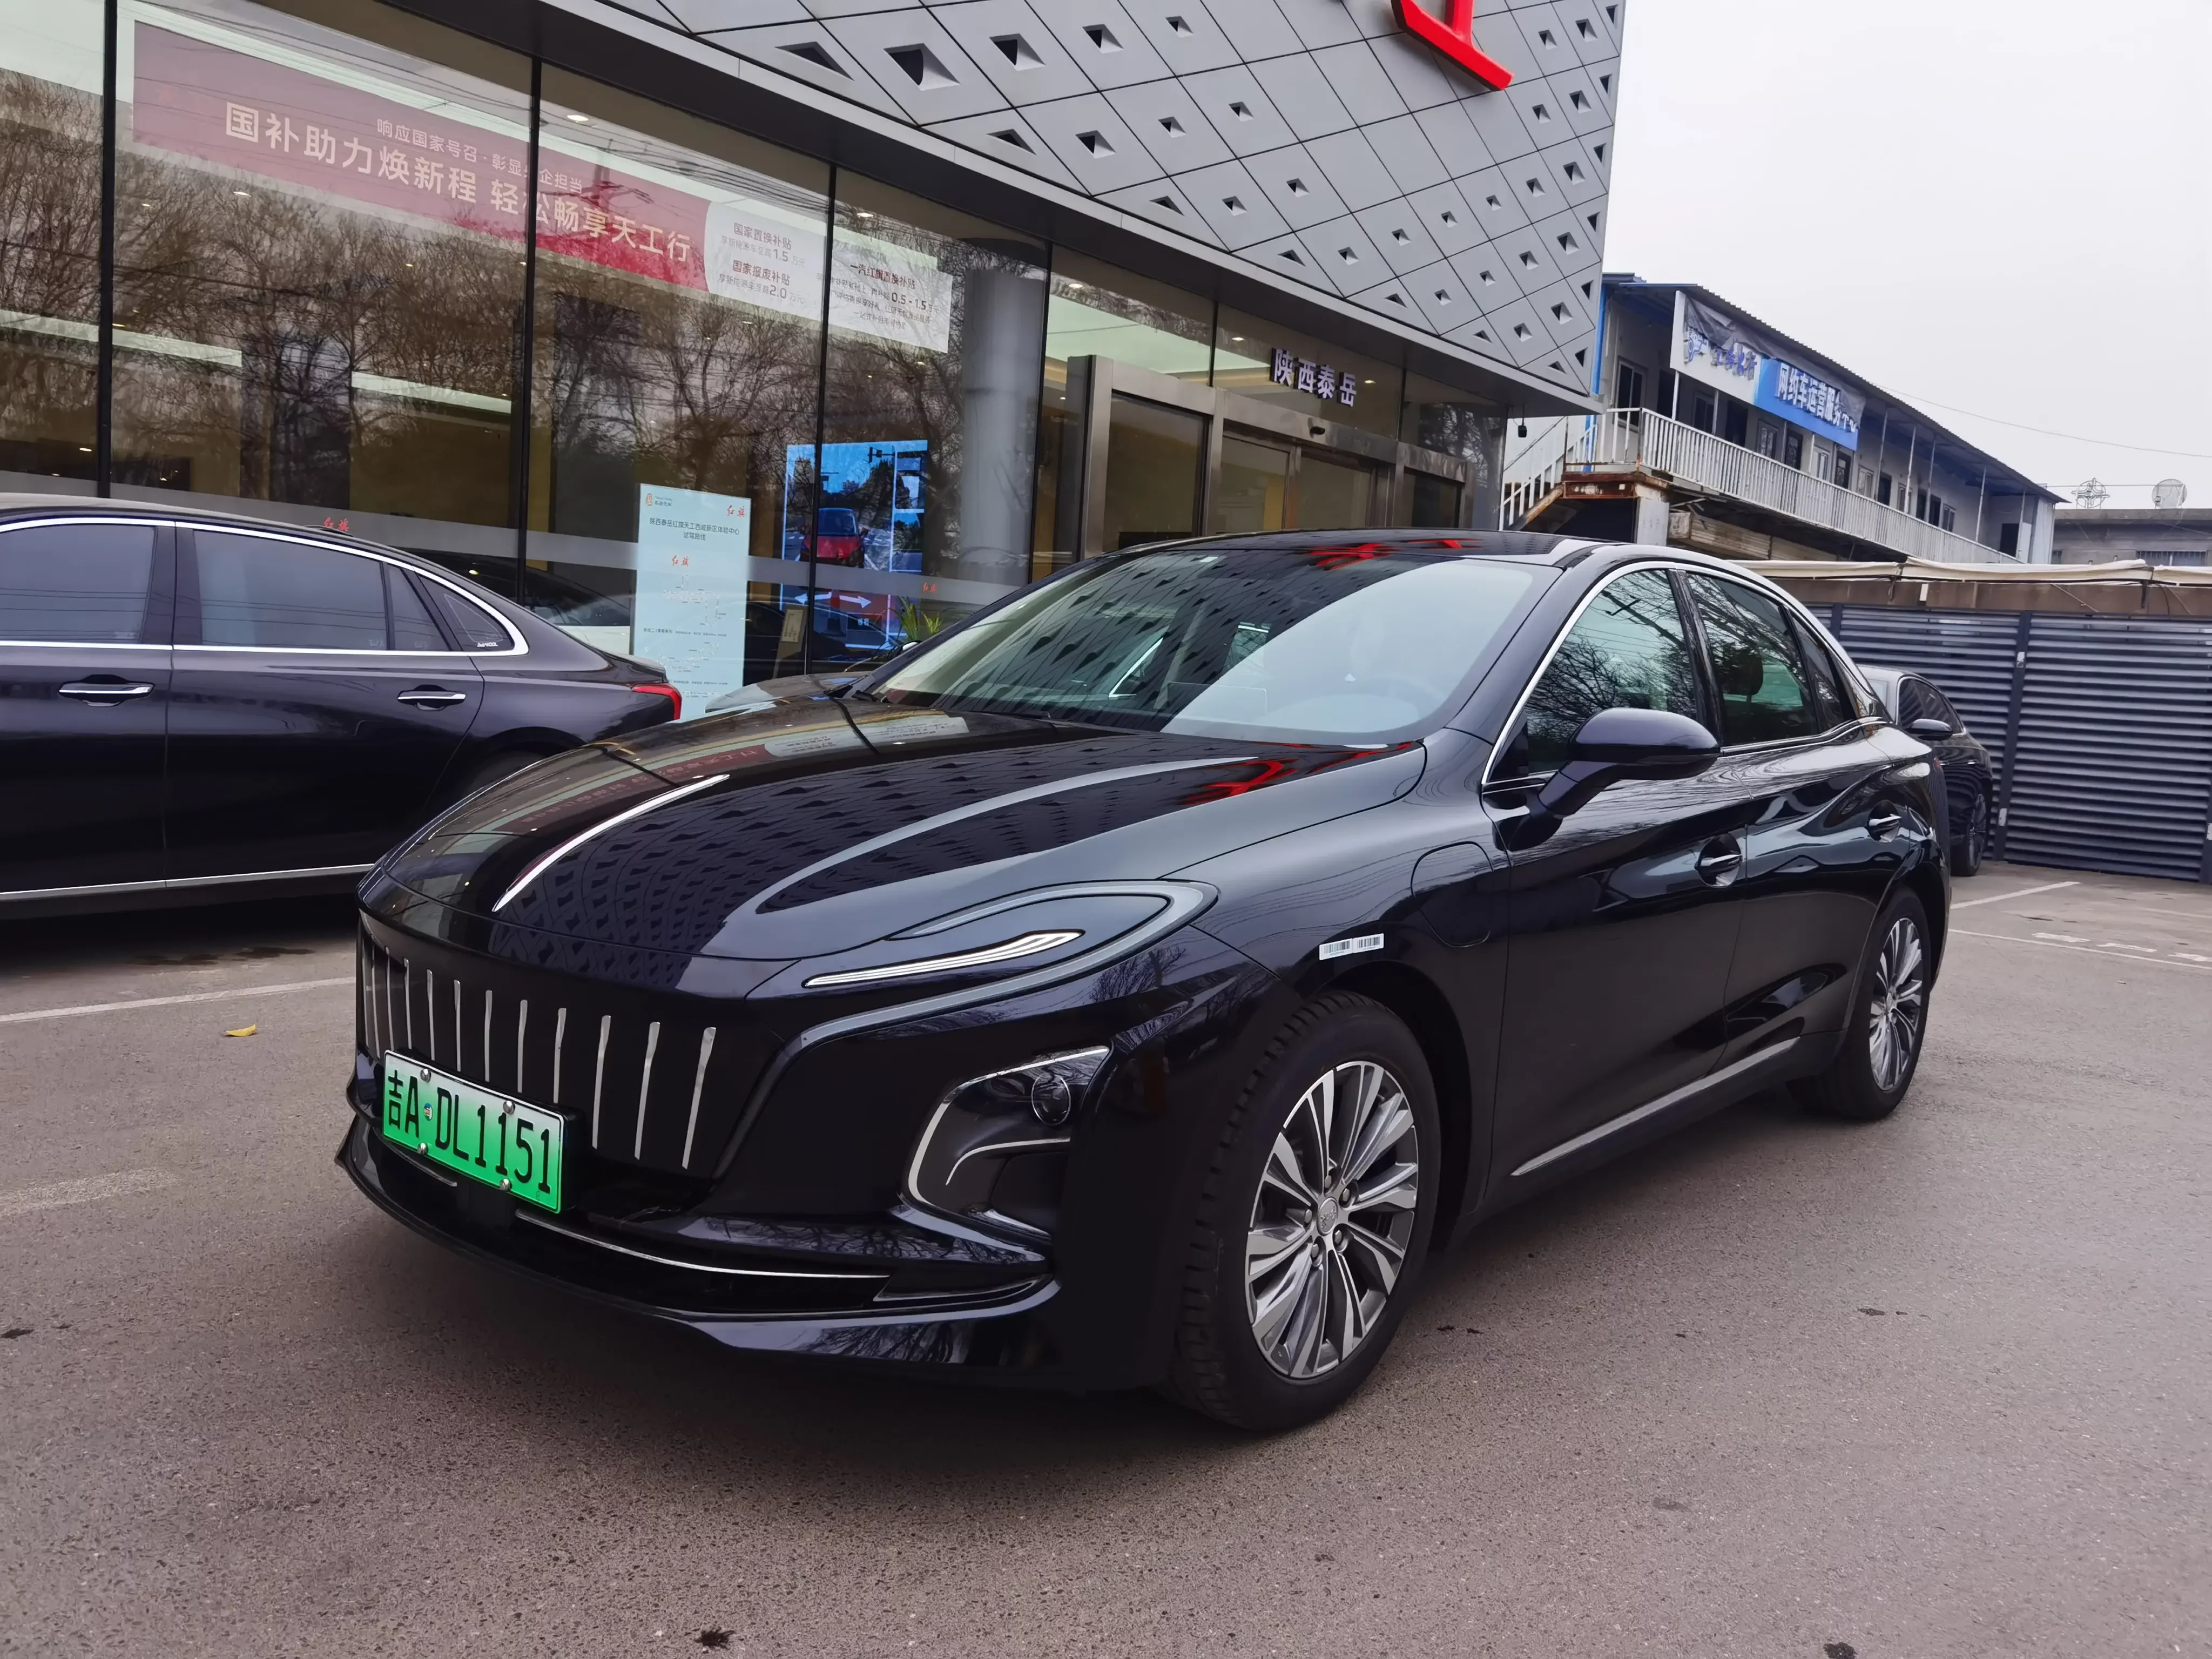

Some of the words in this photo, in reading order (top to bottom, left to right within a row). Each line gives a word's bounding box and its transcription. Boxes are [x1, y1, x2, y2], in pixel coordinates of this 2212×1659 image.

[226, 102, 476, 204] 国补助力焕新程
[377, 118, 582, 194] 响应国家号召·彰显企担当
[734, 222, 792, 250] 国家置换补贴
[733, 260, 790, 286] 国家报废补贴
[1272, 348, 1357, 407] 陕西泰岳
[727, 505, 746, 518] 红旗
